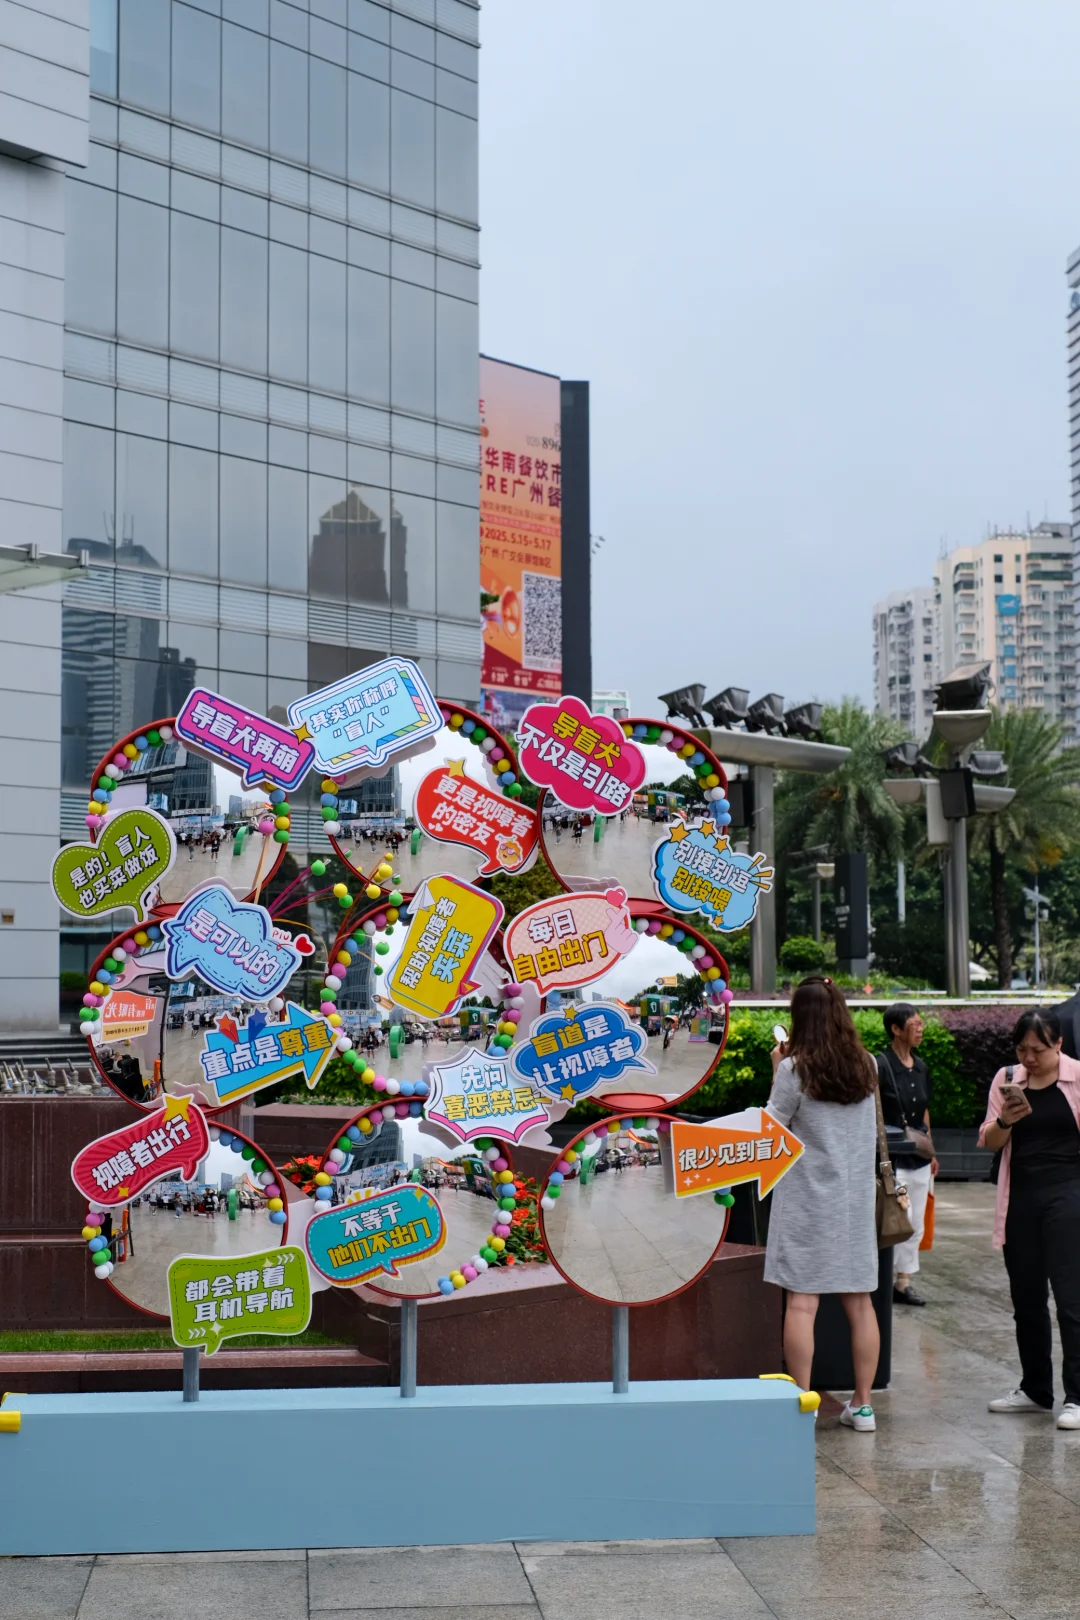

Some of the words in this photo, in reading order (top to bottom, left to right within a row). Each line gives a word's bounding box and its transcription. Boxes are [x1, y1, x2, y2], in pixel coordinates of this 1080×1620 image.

[479, 445, 561, 484] 华南餐饮市
[479, 472, 561, 508] RE广州餐
[310, 677, 399, 732] 其实你称呼
[191, 700, 300, 774] 导盲犬再萌
[552, 711, 621, 768] 导盲犬
[516, 722, 632, 808] 不仅是引路
[431, 801, 488, 845] 的密友
[433, 773, 534, 838] 更是视障者
[79, 844, 160, 909] 也买菜做饭
[670, 869, 732, 912] 别投喂
[674, 840, 751, 894] 别摸别逗
[185, 908, 281, 984] 是可以的
[400, 897, 457, 990] 帮助视障者
[528, 909, 578, 944] 每日
[431, 925, 474, 984] 夹菜
[512, 930, 608, 983] 自由出门
[201, 1020, 333, 1081] 重点是尊重
[532, 1014, 612, 1058] 盲道是
[532, 1036, 636, 1089] 让视障者
[443, 1086, 539, 1123] 喜恶禁忌
[461, 1063, 508, 1093] 先问
[91, 1114, 191, 1193] 视障者出行
[678, 1136, 793, 1172] 很少见到盲人
[326, 1218, 432, 1269] 他们不出门
[339, 1201, 402, 1238] 不等于
[185, 1265, 285, 1303] 都会带着
[193, 1288, 294, 1324] 耳机导航
